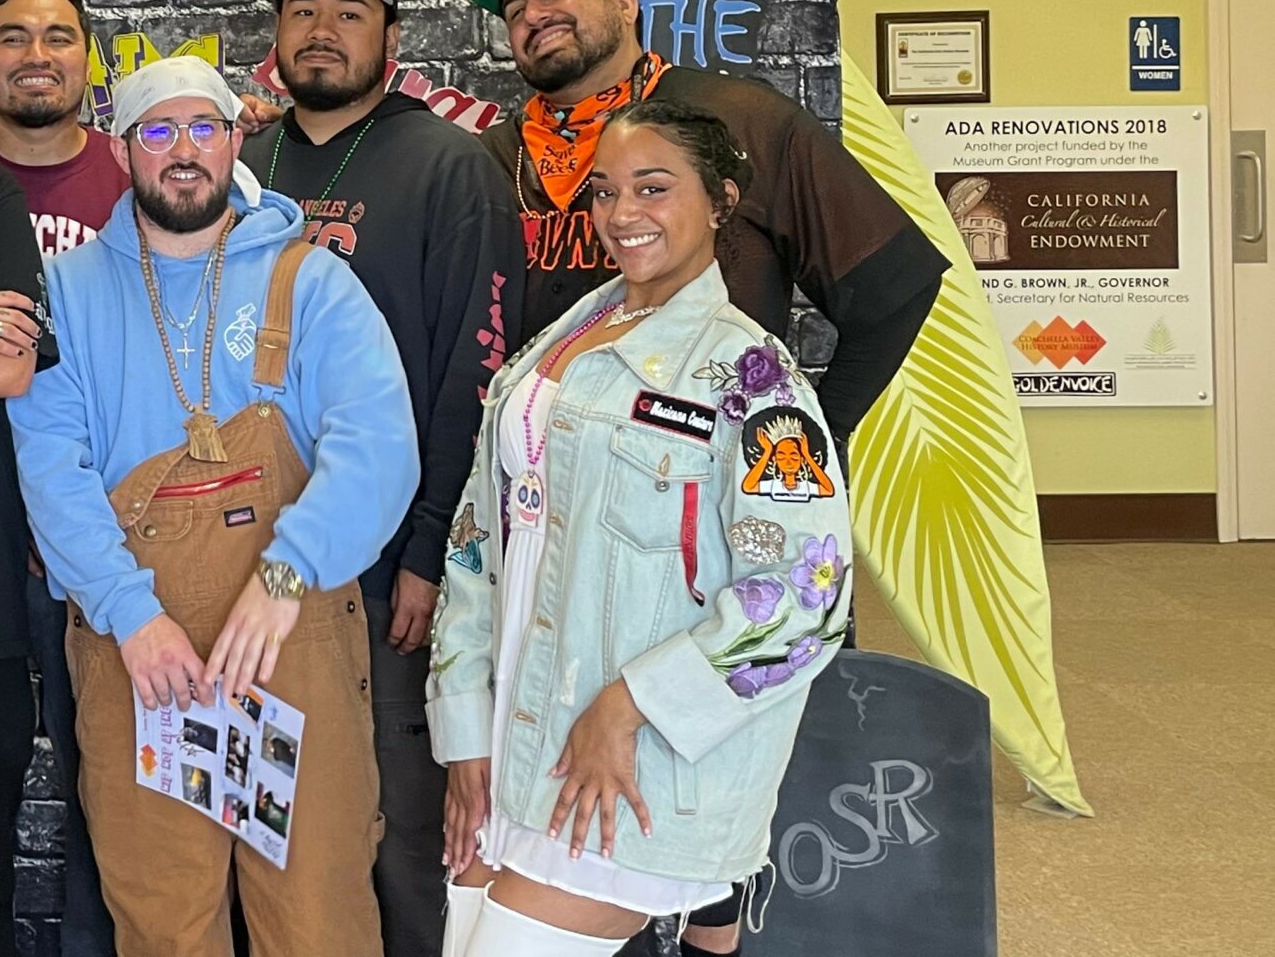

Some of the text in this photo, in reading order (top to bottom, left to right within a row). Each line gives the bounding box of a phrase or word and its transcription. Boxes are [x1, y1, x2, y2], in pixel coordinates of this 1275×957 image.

[1138, 71, 1173, 79] WOMEN
[945, 119, 1167, 135] ADA RENOVATIONS 2018
[964, 140, 1148, 153] Another project funded by the
[953, 154, 1159, 168] Museum Grant Program under the
[1027, 194, 1150, 207] CALIFORNIA
[1021, 208, 1167, 230] Cultural & Historical
[1030, 234, 1151, 248] ENDOWMENT
[1003, 279, 1017, 289] G.
[1021, 278, 1070, 289] BROWN,
[1098, 278, 1170, 288] GOVERNOR
[997, 293, 1056, 305] Secretary
[1059, 292, 1076, 303] for
[1079, 293, 1124, 303] Natural
[1127, 293, 1190, 303] Resources
[778, 759, 940, 900] OSR
